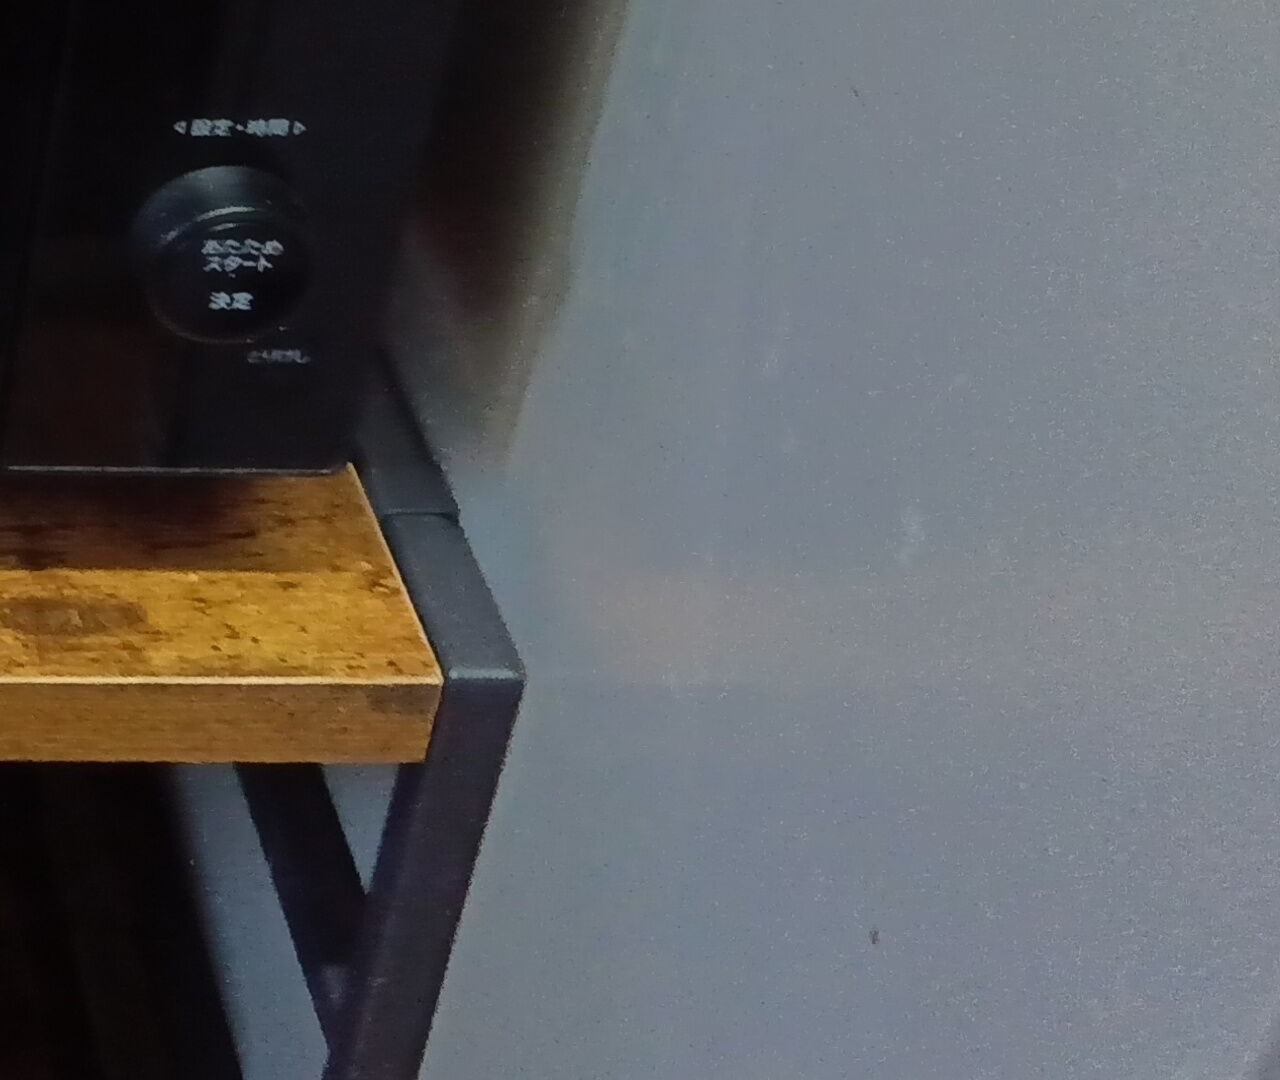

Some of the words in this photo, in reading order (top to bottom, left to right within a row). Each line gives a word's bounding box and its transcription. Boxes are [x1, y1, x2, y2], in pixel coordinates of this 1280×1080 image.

[200, 238, 285, 257] あたため
[202, 254, 274, 273] スタート
[207, 291, 255, 312] 決定
